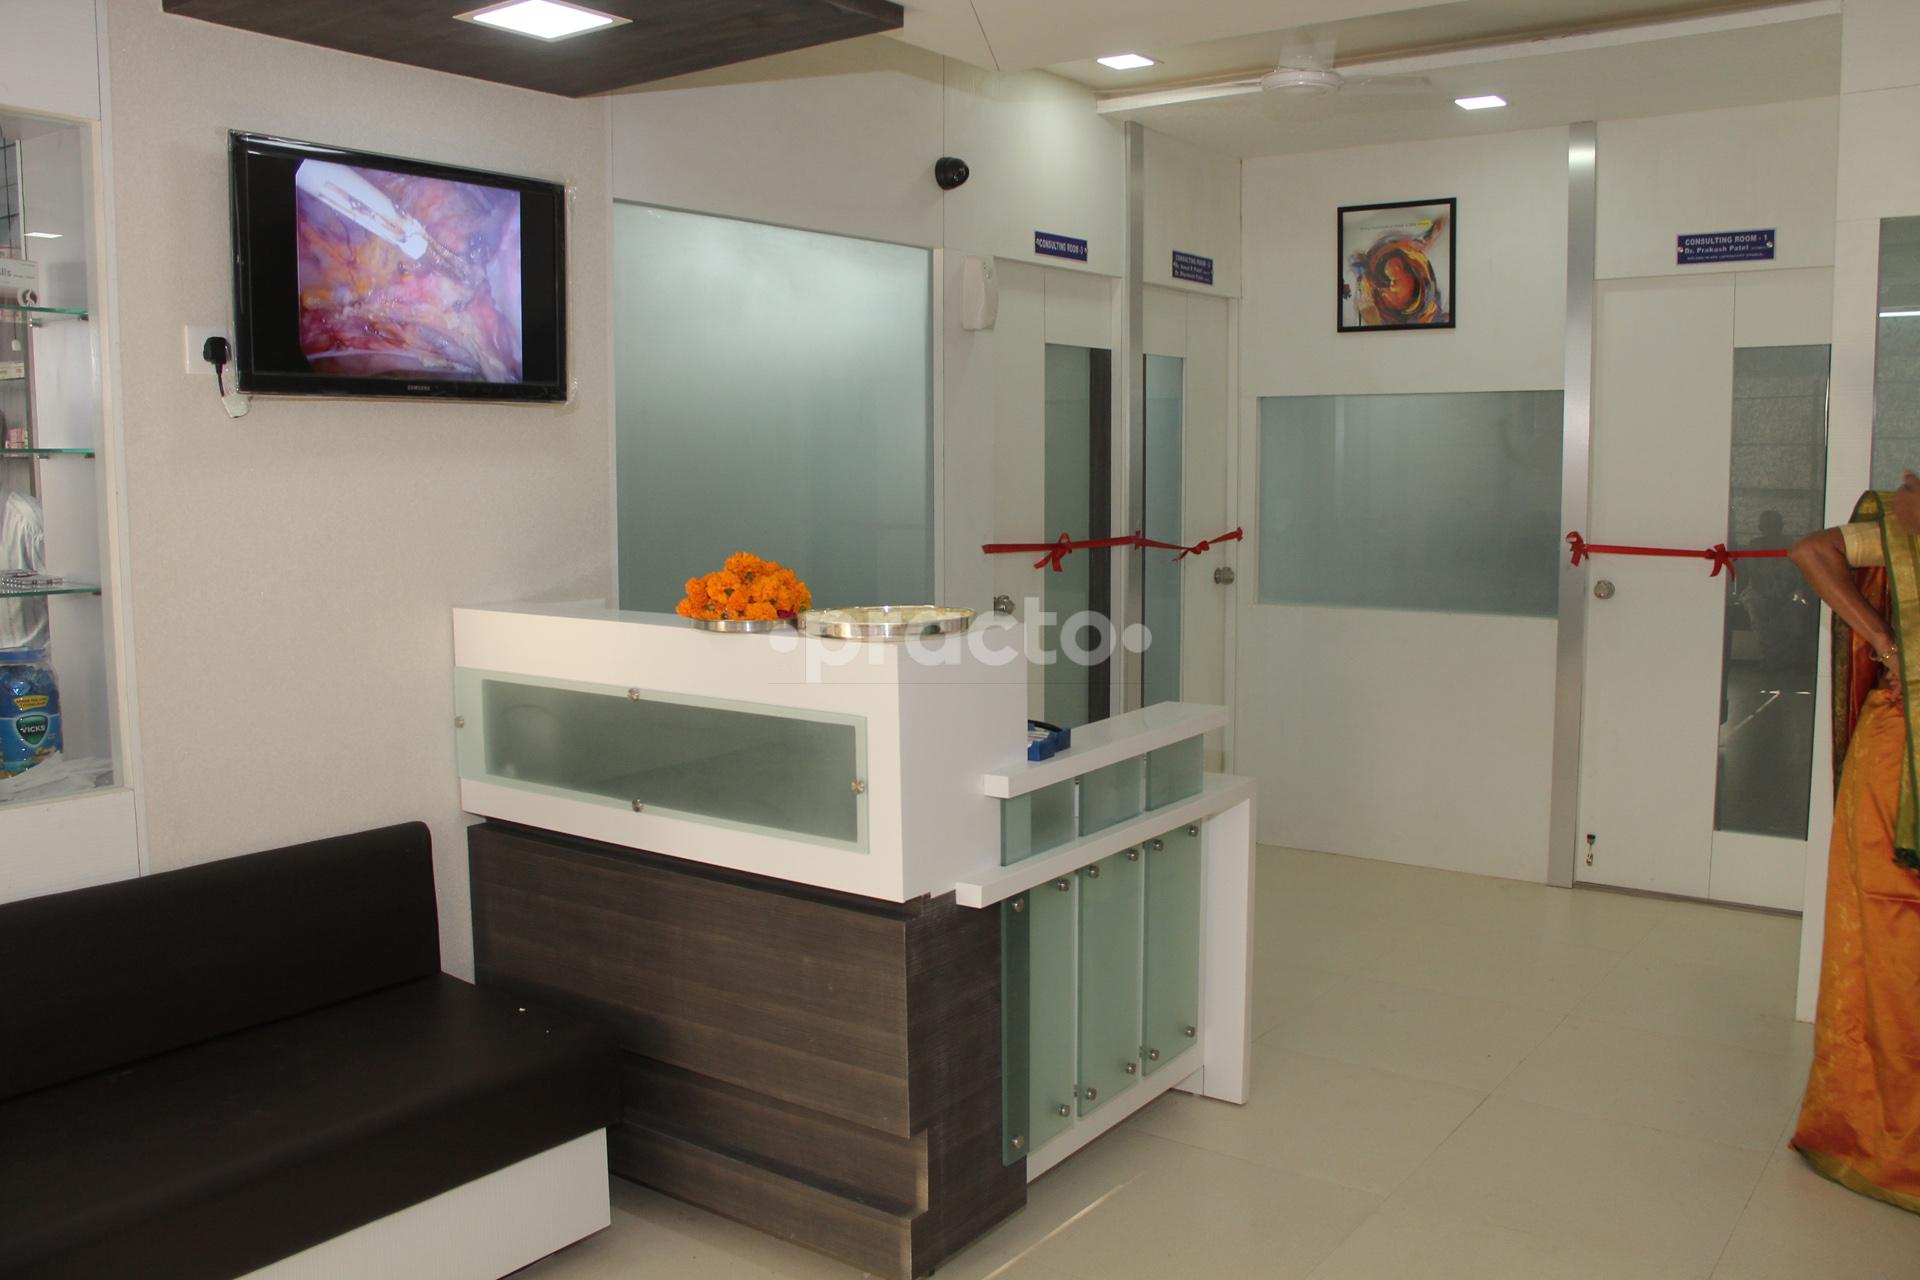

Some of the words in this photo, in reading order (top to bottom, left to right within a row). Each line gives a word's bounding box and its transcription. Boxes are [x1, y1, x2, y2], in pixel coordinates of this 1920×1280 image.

[1685, 236, 1733, 246] CONSULTING
[1734, 234, 1757, 243] ROOM
[1697, 245, 1727, 254] Prakash
[22, 725, 46, 733] VICKS
